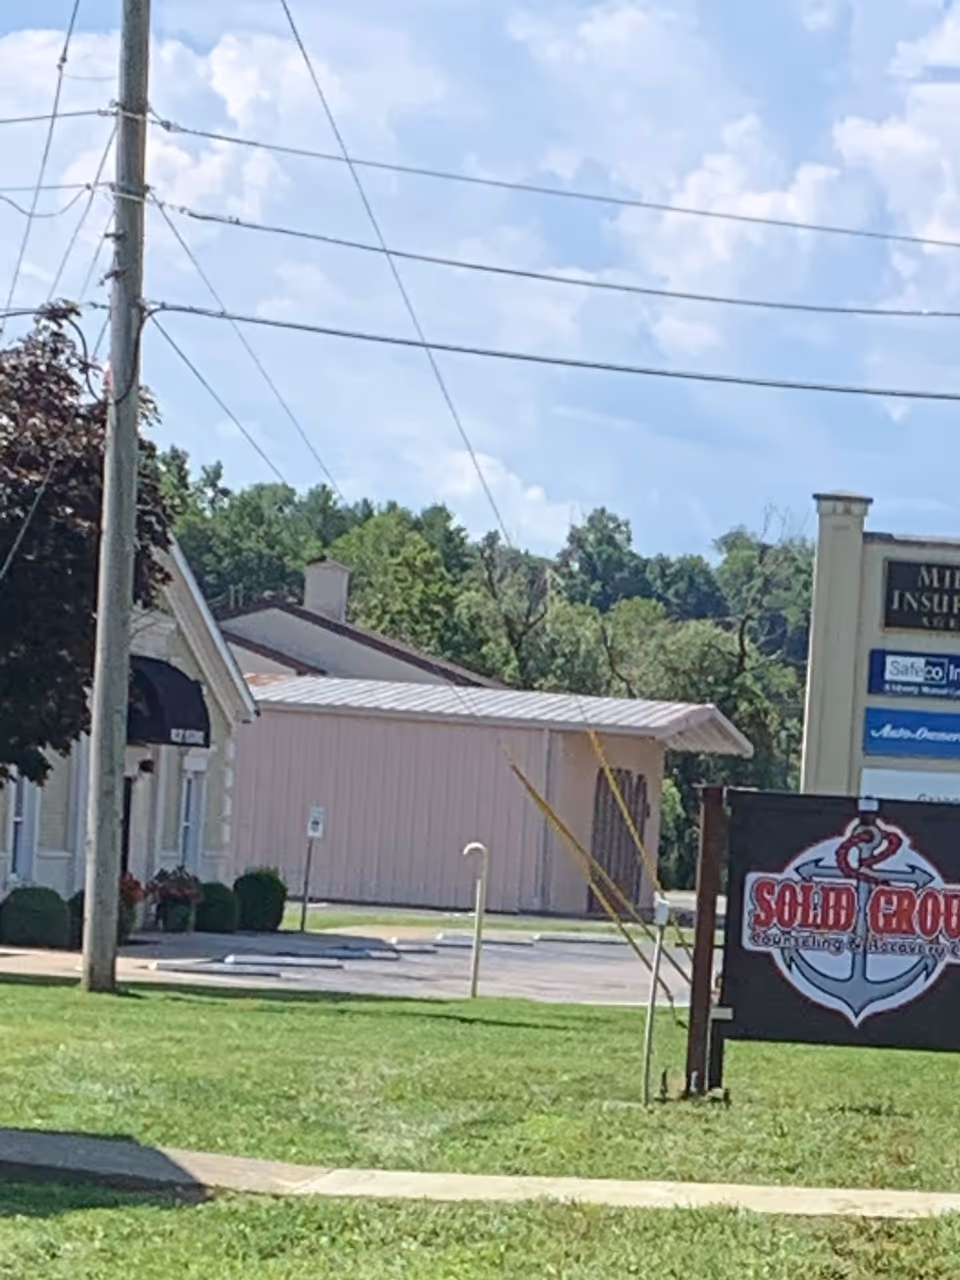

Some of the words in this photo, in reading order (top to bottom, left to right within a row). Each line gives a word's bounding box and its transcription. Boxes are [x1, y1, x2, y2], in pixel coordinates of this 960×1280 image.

[888, 659, 943, 681] Safeco
[752, 878, 859, 931] SOLID
[751, 930, 845, 956] Counseling
[869, 938, 945, 959] Recovery
